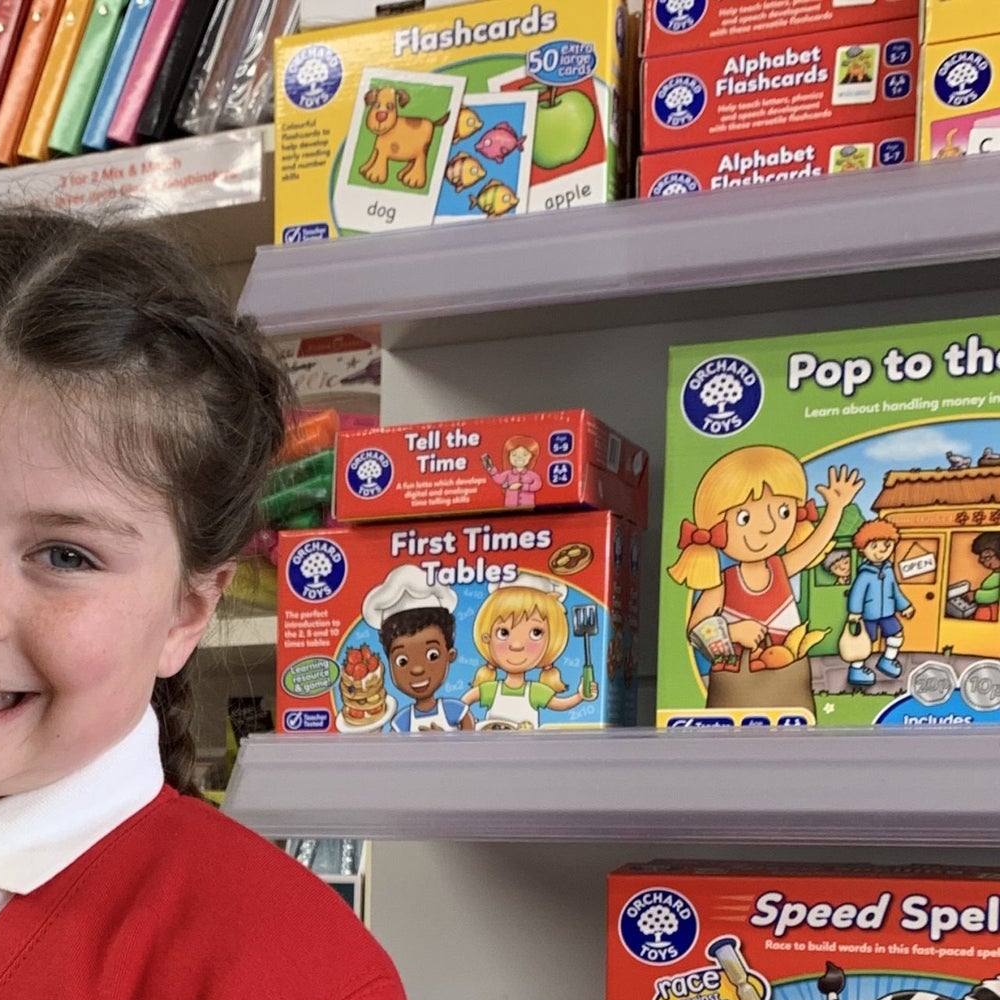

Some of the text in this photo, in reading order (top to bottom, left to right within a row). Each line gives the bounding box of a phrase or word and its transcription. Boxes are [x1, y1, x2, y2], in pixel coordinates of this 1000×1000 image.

[394, 5, 556, 57] Flashcards
[668, 18, 694, 30] TOYS
[561, 44, 593, 54] extra
[289, 46, 339, 73] ORCHARD
[529, 49, 559, 73] 50
[560, 54, 591, 66] large
[723, 46, 822, 76] Alphabet
[939, 53, 988, 77] ORCHARD
[558, 65, 592, 77] cards
[715, 64, 829, 97] Flashcards
[658, 77, 703, 100] ORCHARD
[948, 91, 978, 105] TOYS
[300, 92, 329, 108] TOYS
[667, 113, 694, 127] TOYS
[718, 145, 816, 174] Alphabet
[653, 171, 697, 194] ORCHARD
[544, 183, 592, 210] apple
[367, 200, 397, 223] dog
[689, 359, 756, 390] ORCHARD
[788, 333, 1000, 397] Pop to th
[804, 404, 839, 418] Learn
[842, 401, 880, 416] about
[882, 396, 940, 415] handling
[941, 395, 987, 411] money
[702, 415, 742, 434] TOYS
[405, 428, 480, 452] Tell the
[552, 442, 570, 453] 5-9
[350, 449, 389, 471] ORCHARD
[416, 453, 467, 474] Time
[552, 474, 569, 484] 2-4
[357, 485, 382, 498] TOYS
[391, 526, 551, 557] First Times
[292, 540, 342, 566] ORCHARD
[422, 557, 518, 586] Tables
[901, 558, 934, 574] OPEN
[303, 585, 332, 600] TOYS
[284, 619, 340, 629] introduction to
[285, 610, 328, 620] The perfect
[284, 630, 297, 638] the
[313, 629, 328, 637] and
[330, 628, 339, 636] 10
[284, 638, 330, 648] times tables
[291, 660, 330, 675] Learning
[293, 669, 330, 684] resource
[295, 679, 331, 693] & game!
[916, 678, 950, 694] 20p
[304, 713, 328, 722] Teacher
[627, 892, 692, 922] ORCHARD
[751, 892, 1000, 941] Speed Spel
[640, 944, 678, 961] TOYS
[765, 940, 791, 950] Race
[794, 941, 806, 951] to
[808, 941, 836, 952] build
[838, 942, 873, 954] words
[875, 942, 885, 953] in
[888, 944, 910, 955] this
[912, 944, 974, 958] fast-paced
[659, 971, 720, 1000] race
